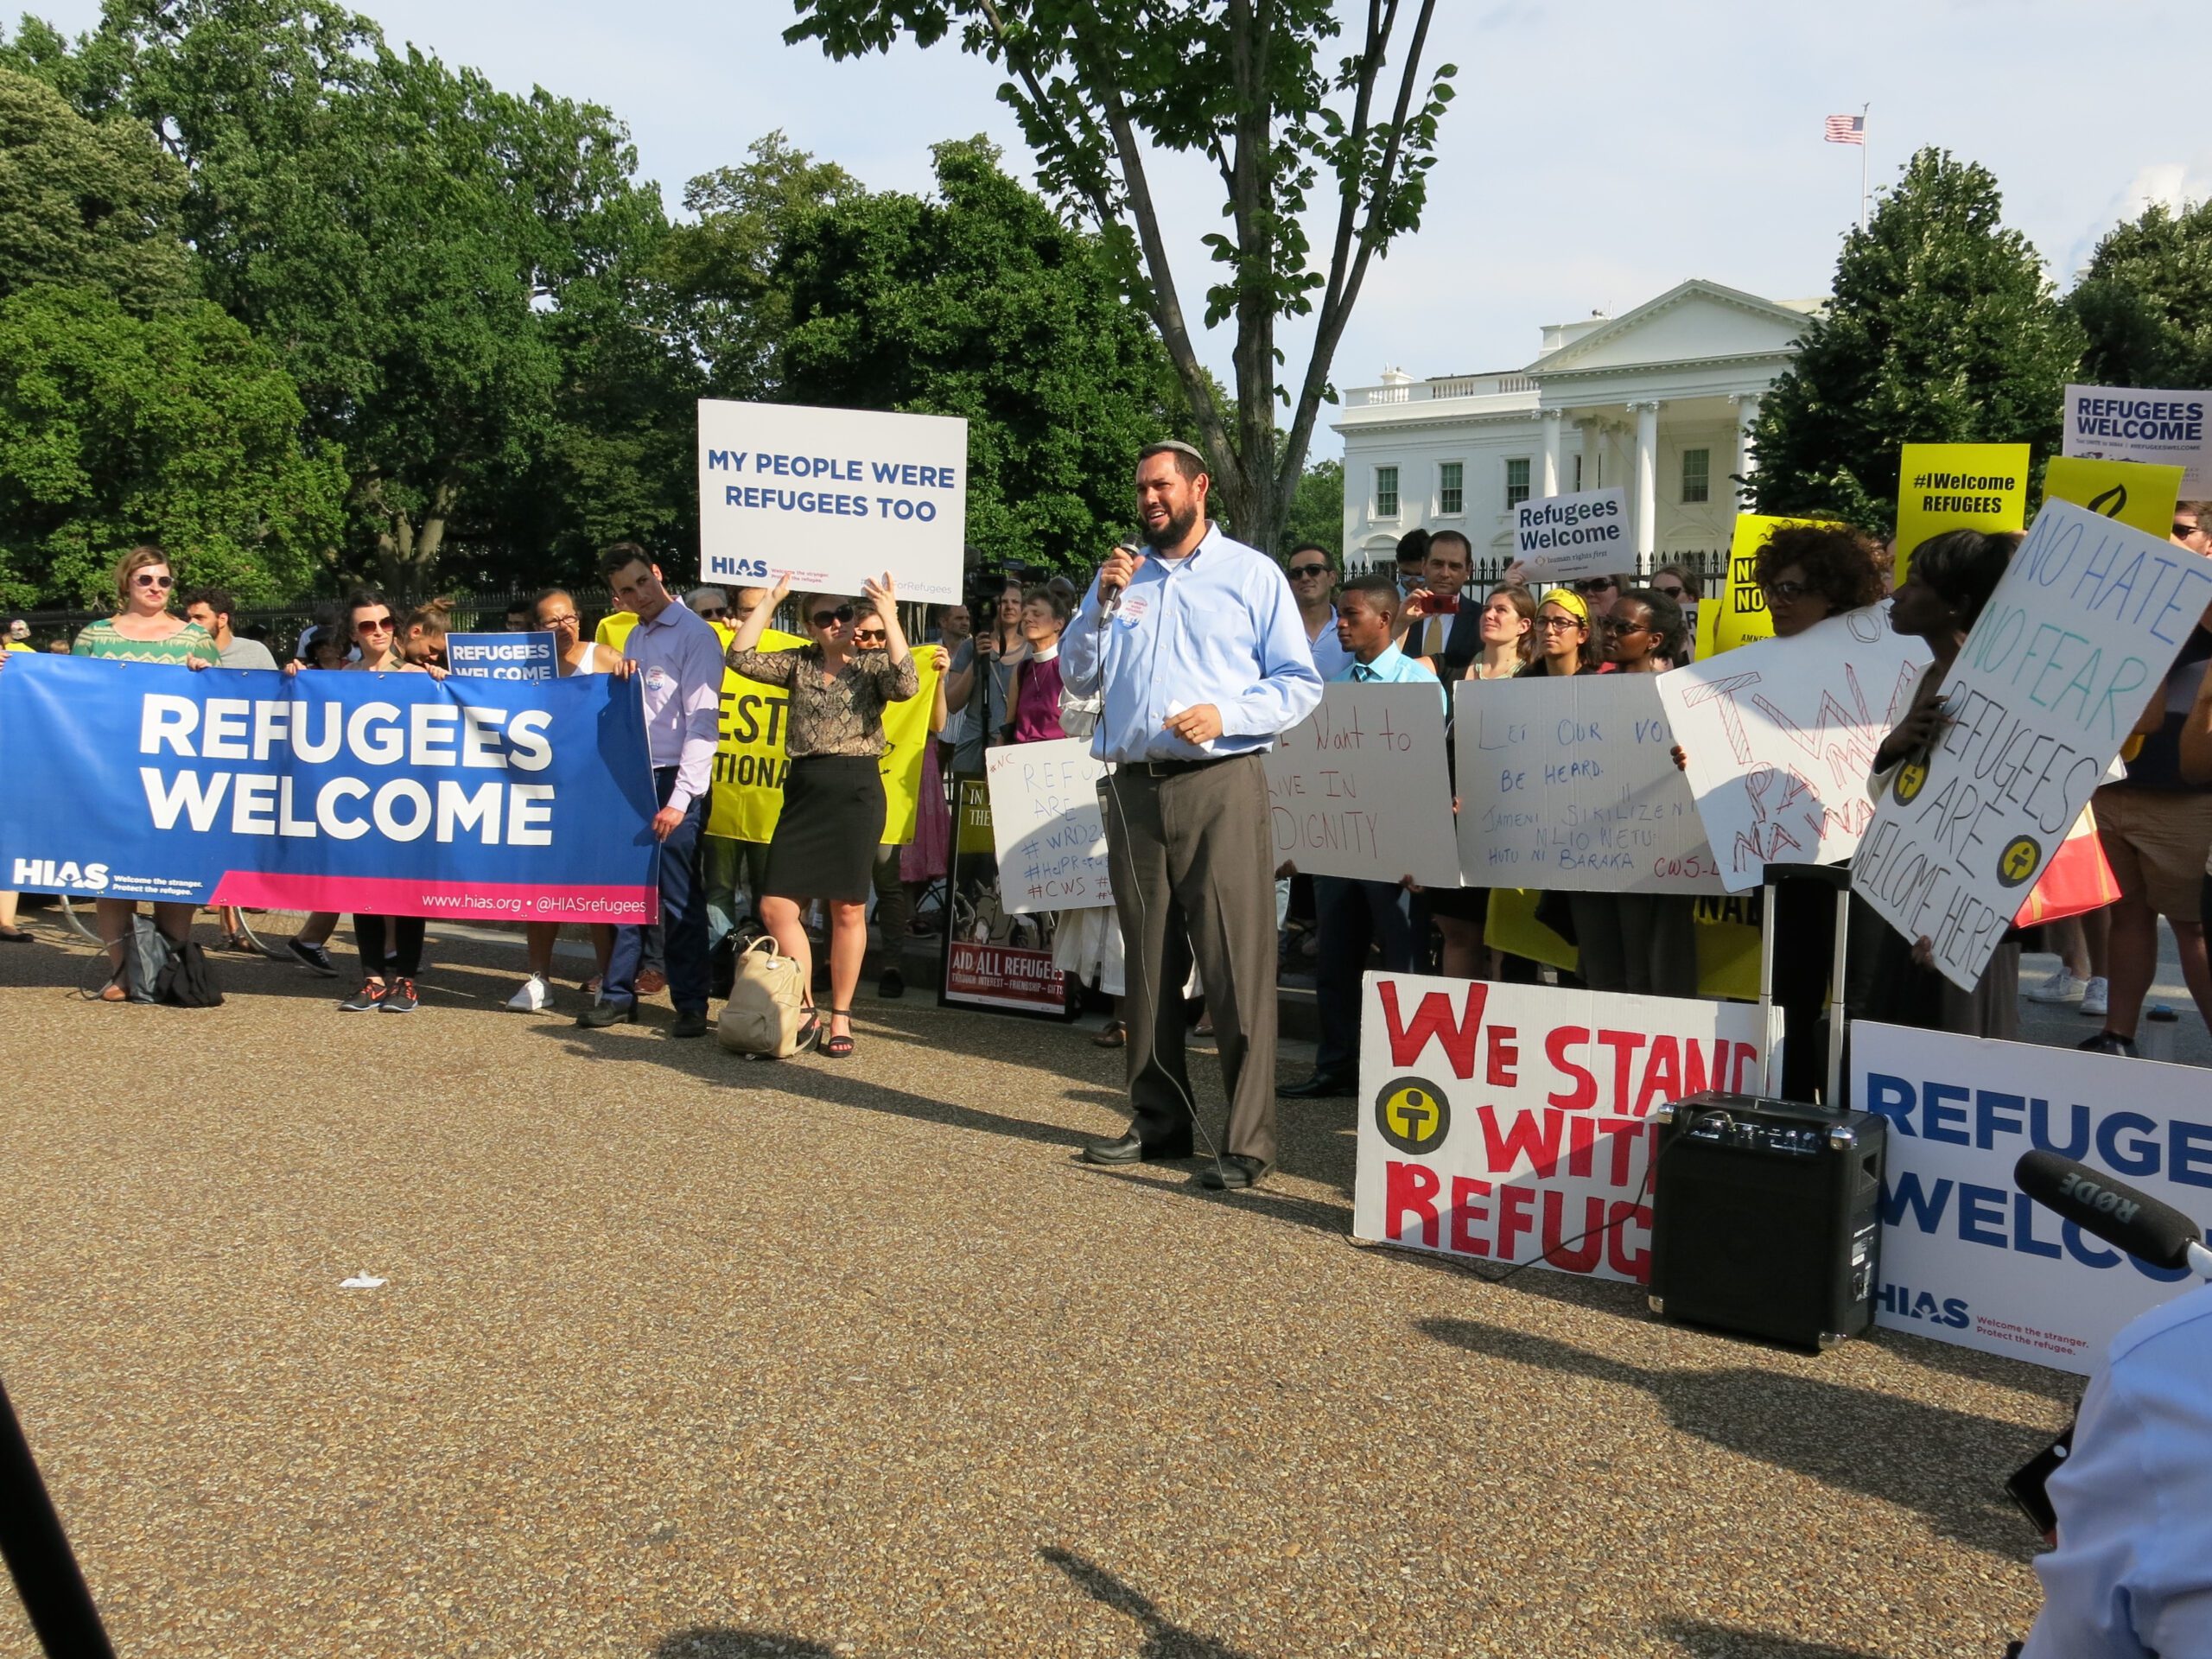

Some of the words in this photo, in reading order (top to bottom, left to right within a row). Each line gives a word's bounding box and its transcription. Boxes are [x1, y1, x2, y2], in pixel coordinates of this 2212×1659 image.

[2078, 397, 2203, 422] REFUGEES
[2077, 416, 2202, 441] WELCOME
[709, 449, 747, 472] MY
[756, 453, 863, 482] PEOPLE
[871, 461, 955, 489] WERE
[1914, 473, 2015, 491] #IWelcome
[726, 485, 868, 517] REFUGEES
[876, 497, 937, 523] TOO
[1521, 500, 1618, 528] Refugees
[1923, 495, 2002, 513] REFUGEES
[1521, 524, 1621, 551] Welcome
[712, 556, 768, 578] HIAS
[1548, 555, 1571, 563] human
[1572, 553, 1592, 563] rights
[2013, 514, 2083, 587] NO
[2071, 535, 2212, 645] HATE
[1734, 587, 1765, 614] NO
[453, 644, 550, 661] REFUGEES
[1963, 601, 2025, 673] NO
[2012, 623, 2148, 741] FEAR
[139, 693, 553, 772] REFUGEES
[1379, 709, 1412, 752] to
[1558, 718, 1603, 747] OUR
[989, 753, 1016, 773] #NC
[1943, 680, 2098, 835] REFUGEES
[1319, 771, 1357, 798] IN
[1501, 769, 1526, 793] BE
[139, 766, 555, 846] WELCOME
[970, 788, 983, 805] IN
[1034, 795, 1077, 821] ARE
[1271, 806, 1377, 860] DIGNITY
[1915, 776, 2005, 879] ARE
[1558, 848, 1635, 870] BARAKA
[13, 857, 110, 891] HIAS
[113, 874, 152, 885] Welcome
[153, 877, 168, 886] the
[168, 879, 204, 889] stranger.
[111, 883, 143, 893] Protect
[160, 887, 194, 897] refugee.
[1852, 819, 1952, 939] WELCOME
[1931, 886, 2012, 980] HERE
[422, 894, 522, 911] www.hias.org
[536, 896, 647, 915] @HIASrefugees
[953, 951, 974, 969] AID
[976, 951, 1001, 976] ALL
[978, 976, 1005, 988] INTEREST
[1008, 980, 1042, 993] FRIENDSHIP
[1047, 983, 1065, 995] GIFTS
[1377, 981, 1519, 1088] WE
[2058, 1172, 2140, 1224] RØDE
[1976, 1315, 2022, 1333] Welcome
[2024, 1324, 2042, 1338] the
[2044, 1332, 2089, 1350] stranger.
[1976, 1325, 2013, 1342] Protect
[2015, 1334, 2031, 1345] the
[2033, 1340, 2075, 1356] refugee.
